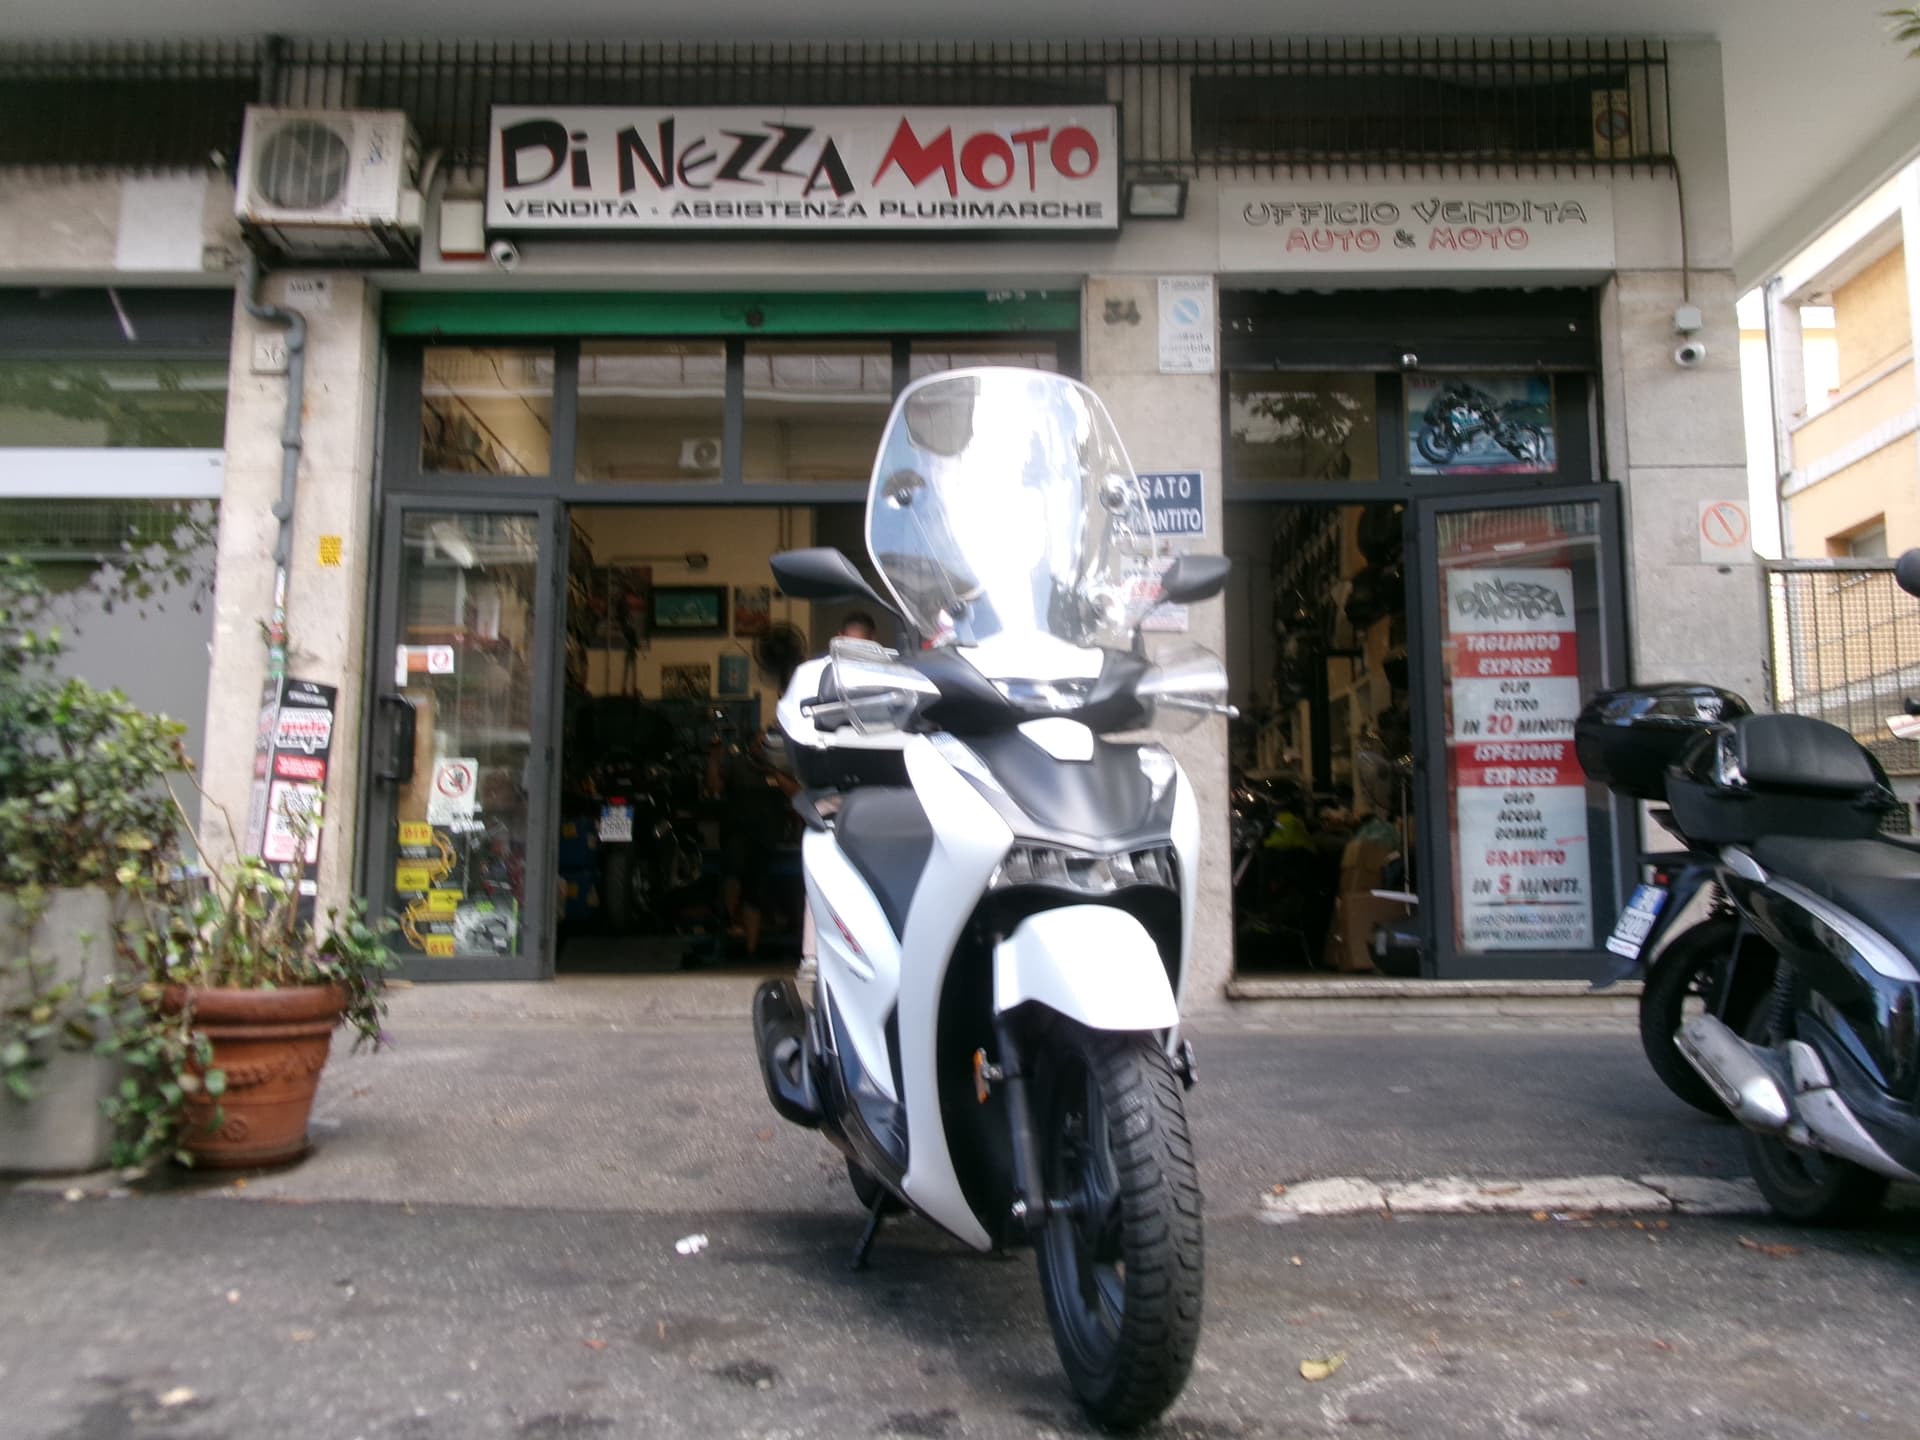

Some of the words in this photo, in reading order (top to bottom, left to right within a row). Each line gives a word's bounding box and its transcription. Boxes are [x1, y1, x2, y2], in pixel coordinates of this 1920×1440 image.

[501, 119, 592, 190] Di
[872, 116, 1099, 199] MOTO
[504, 200, 640, 218] VENDITA
[671, 200, 868, 218] ASSISTENZA
[880, 200, 1103, 218] PLURIMARCHE
[1243, 201, 1400, 226] UFFICIO
[1411, 198, 1589, 225] VENDITA
[1286, 227, 1381, 252] AUTO
[1393, 229, 1416, 249] &
[1428, 226, 1530, 251] MOTO
[1130, 476, 1192, 499] SATO
[1465, 635, 1561, 652] TAGLIANDO
[1478, 658, 1552, 675] EXPRESS
[1500, 681, 1531, 694] OLIO
[1494, 698, 1539, 711] FILTRO
[1463, 719, 1480, 735] IN
[1486, 714, 1514, 735] 20
[1474, 743, 1565, 761] ISPEZIONE
[1483, 767, 1558, 785] EXPRESS
[1503, 791, 1535, 805] OLIO
[1497, 809, 1542, 823] ACQUA
[1494, 827, 1548, 841] GOMME
[1486, 850, 1566, 867] GRATUITO
[1472, 878, 1492, 894] IN
[1497, 873, 1512, 895] 5
